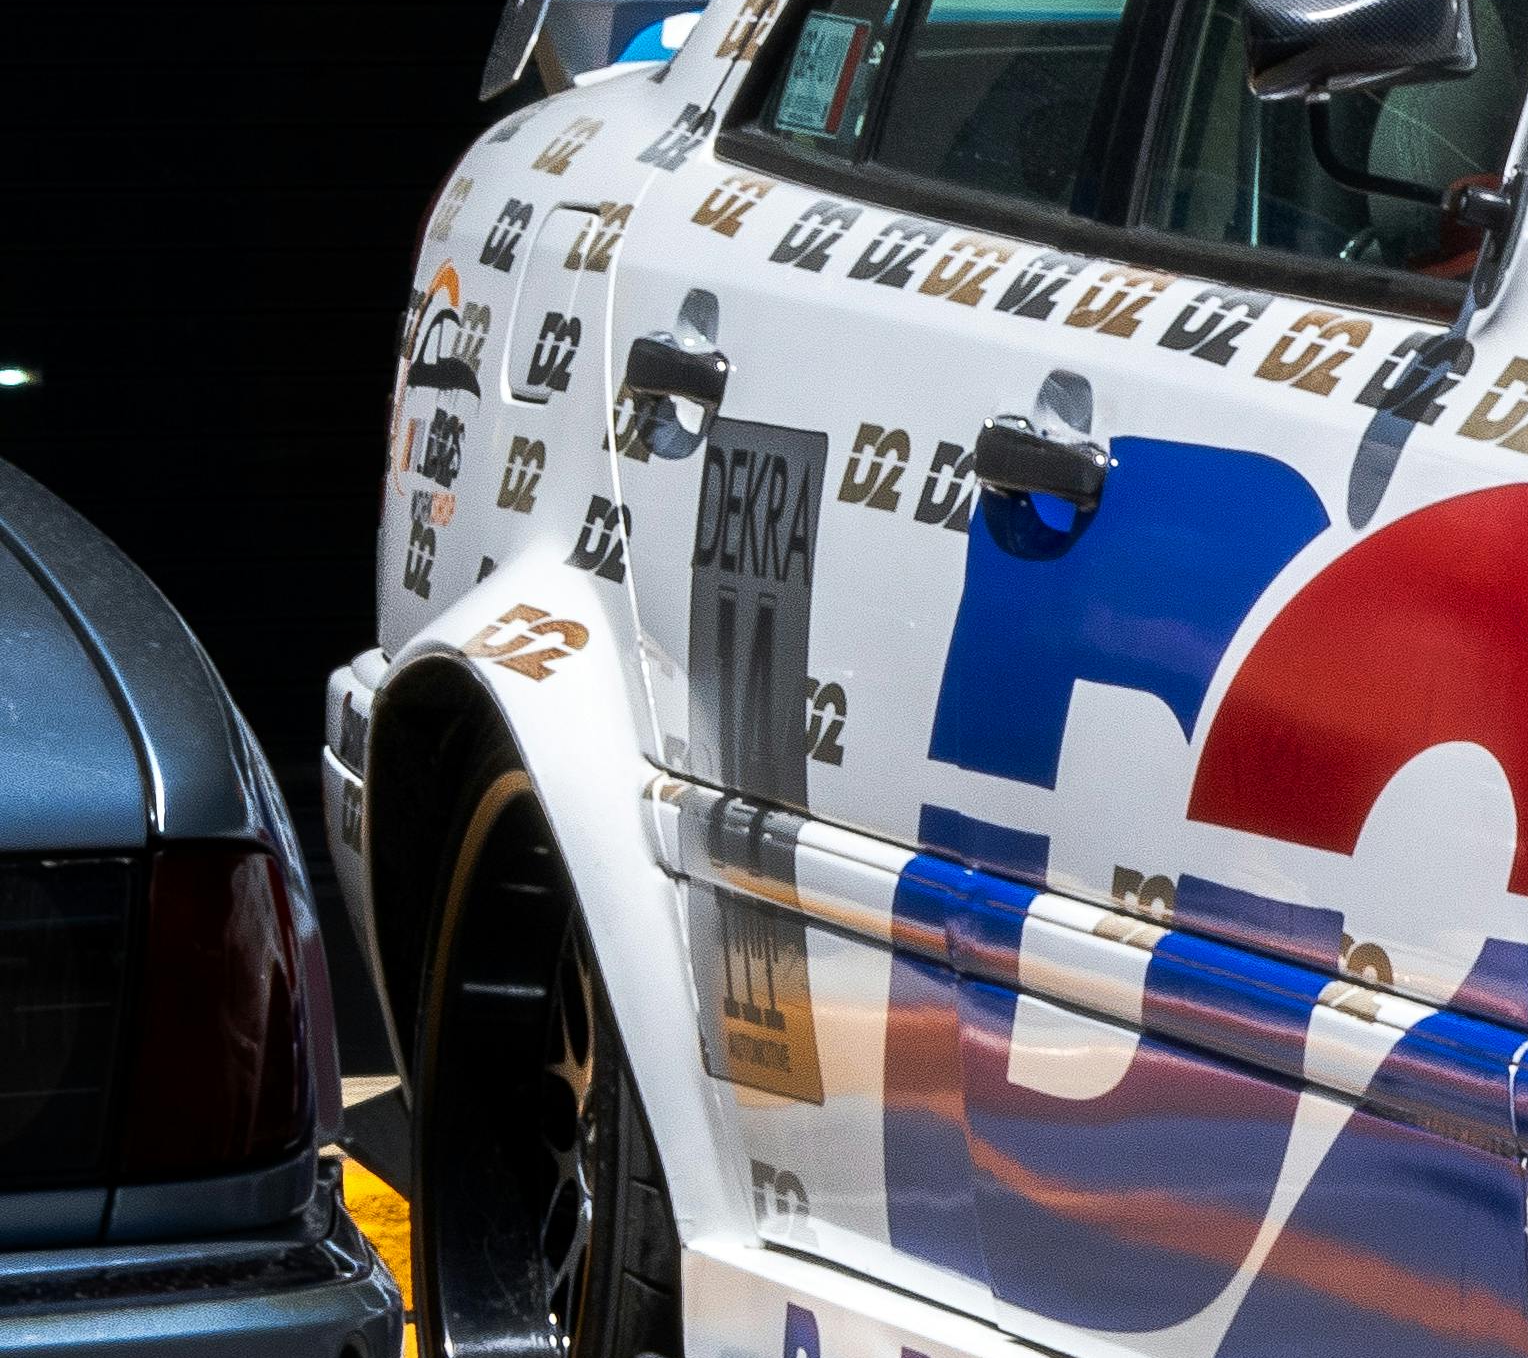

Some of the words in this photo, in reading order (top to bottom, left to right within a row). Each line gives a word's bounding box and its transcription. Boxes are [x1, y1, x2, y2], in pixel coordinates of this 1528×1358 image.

[480, 197, 530, 272] D2
[692, 175, 776, 238] D2
[769, 199, 863, 273] D2
[848, 217, 945, 289] D2
[917, 233, 1012, 308] D2
[995, 250, 1080, 321] D2
[1063, 268, 1173, 340] D2
[1157, 285, 1273, 367] D2
[527, 311, 582, 392] D2
[1253, 309, 1373, 397] D2
[1355, 331, 1475, 425] D2
[497, 435, 547, 515] D2
[838, 423, 911, 513] D2
[566, 494, 632, 584] D2
[697, 445, 814, 587] DEKRA
[466, 603, 590, 682] D2
